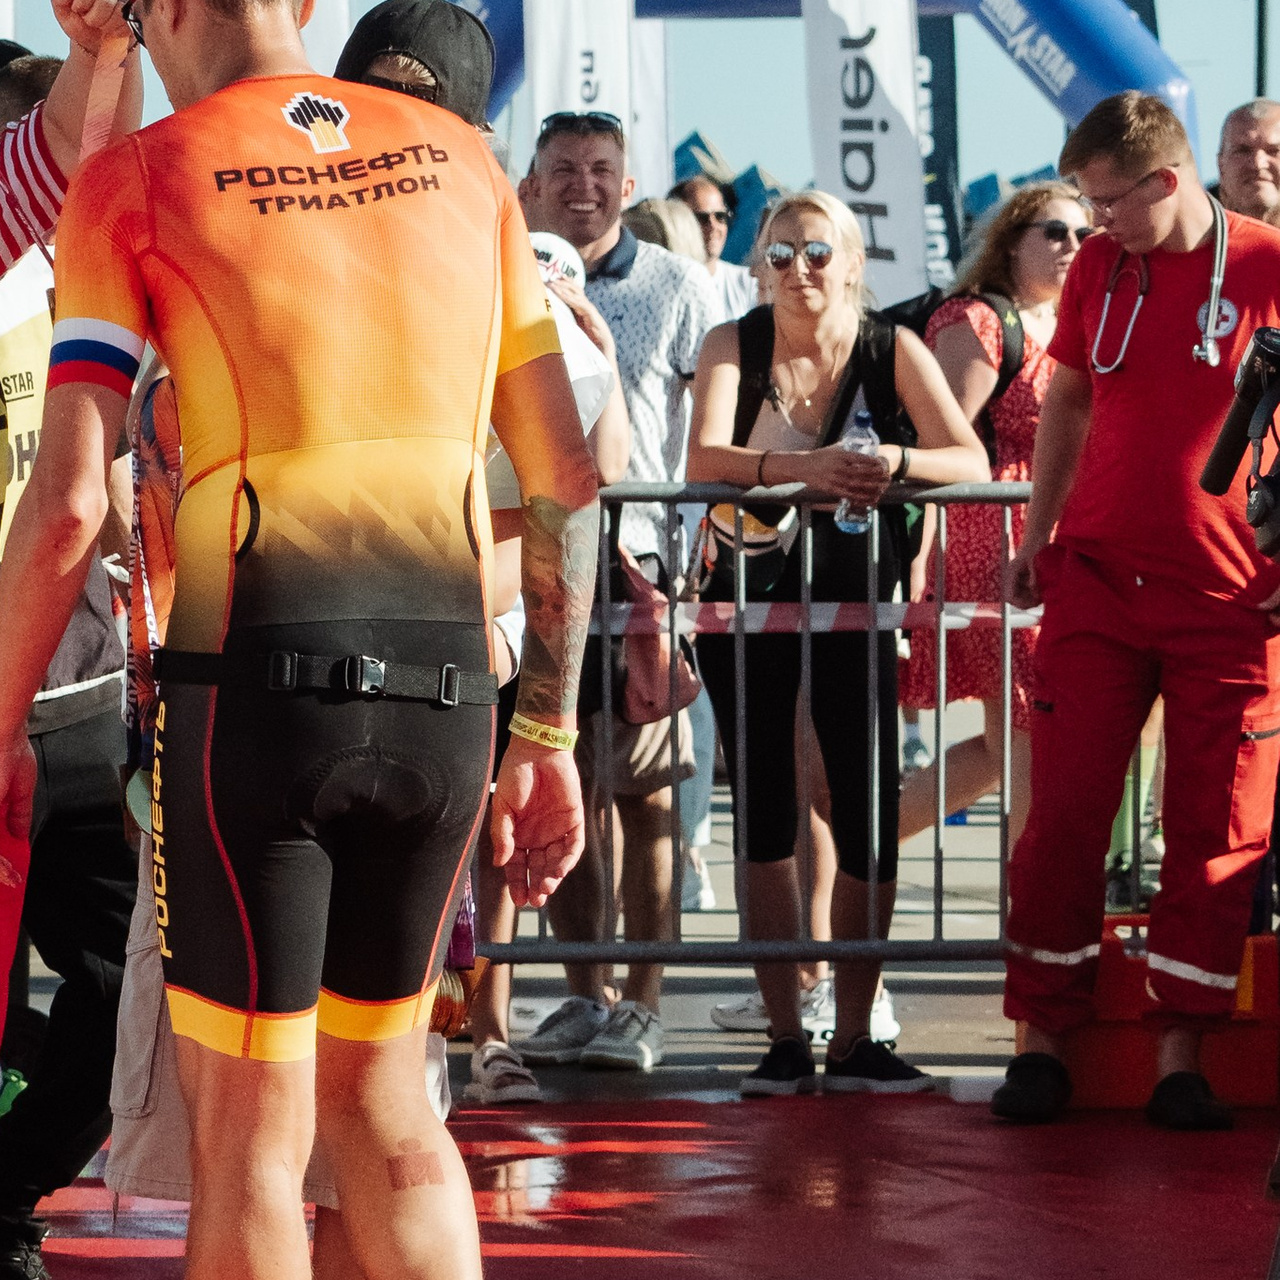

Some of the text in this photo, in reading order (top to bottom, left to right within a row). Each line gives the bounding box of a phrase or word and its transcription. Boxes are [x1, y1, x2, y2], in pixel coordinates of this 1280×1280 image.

[213, 143, 450, 192] РОСНЕФТЬ
[249, 174, 441, 216] ТРИАТЛОН
[2, 371, 35, 396] STAR
[149, 700, 174, 959] РОСНЕФТЬ
